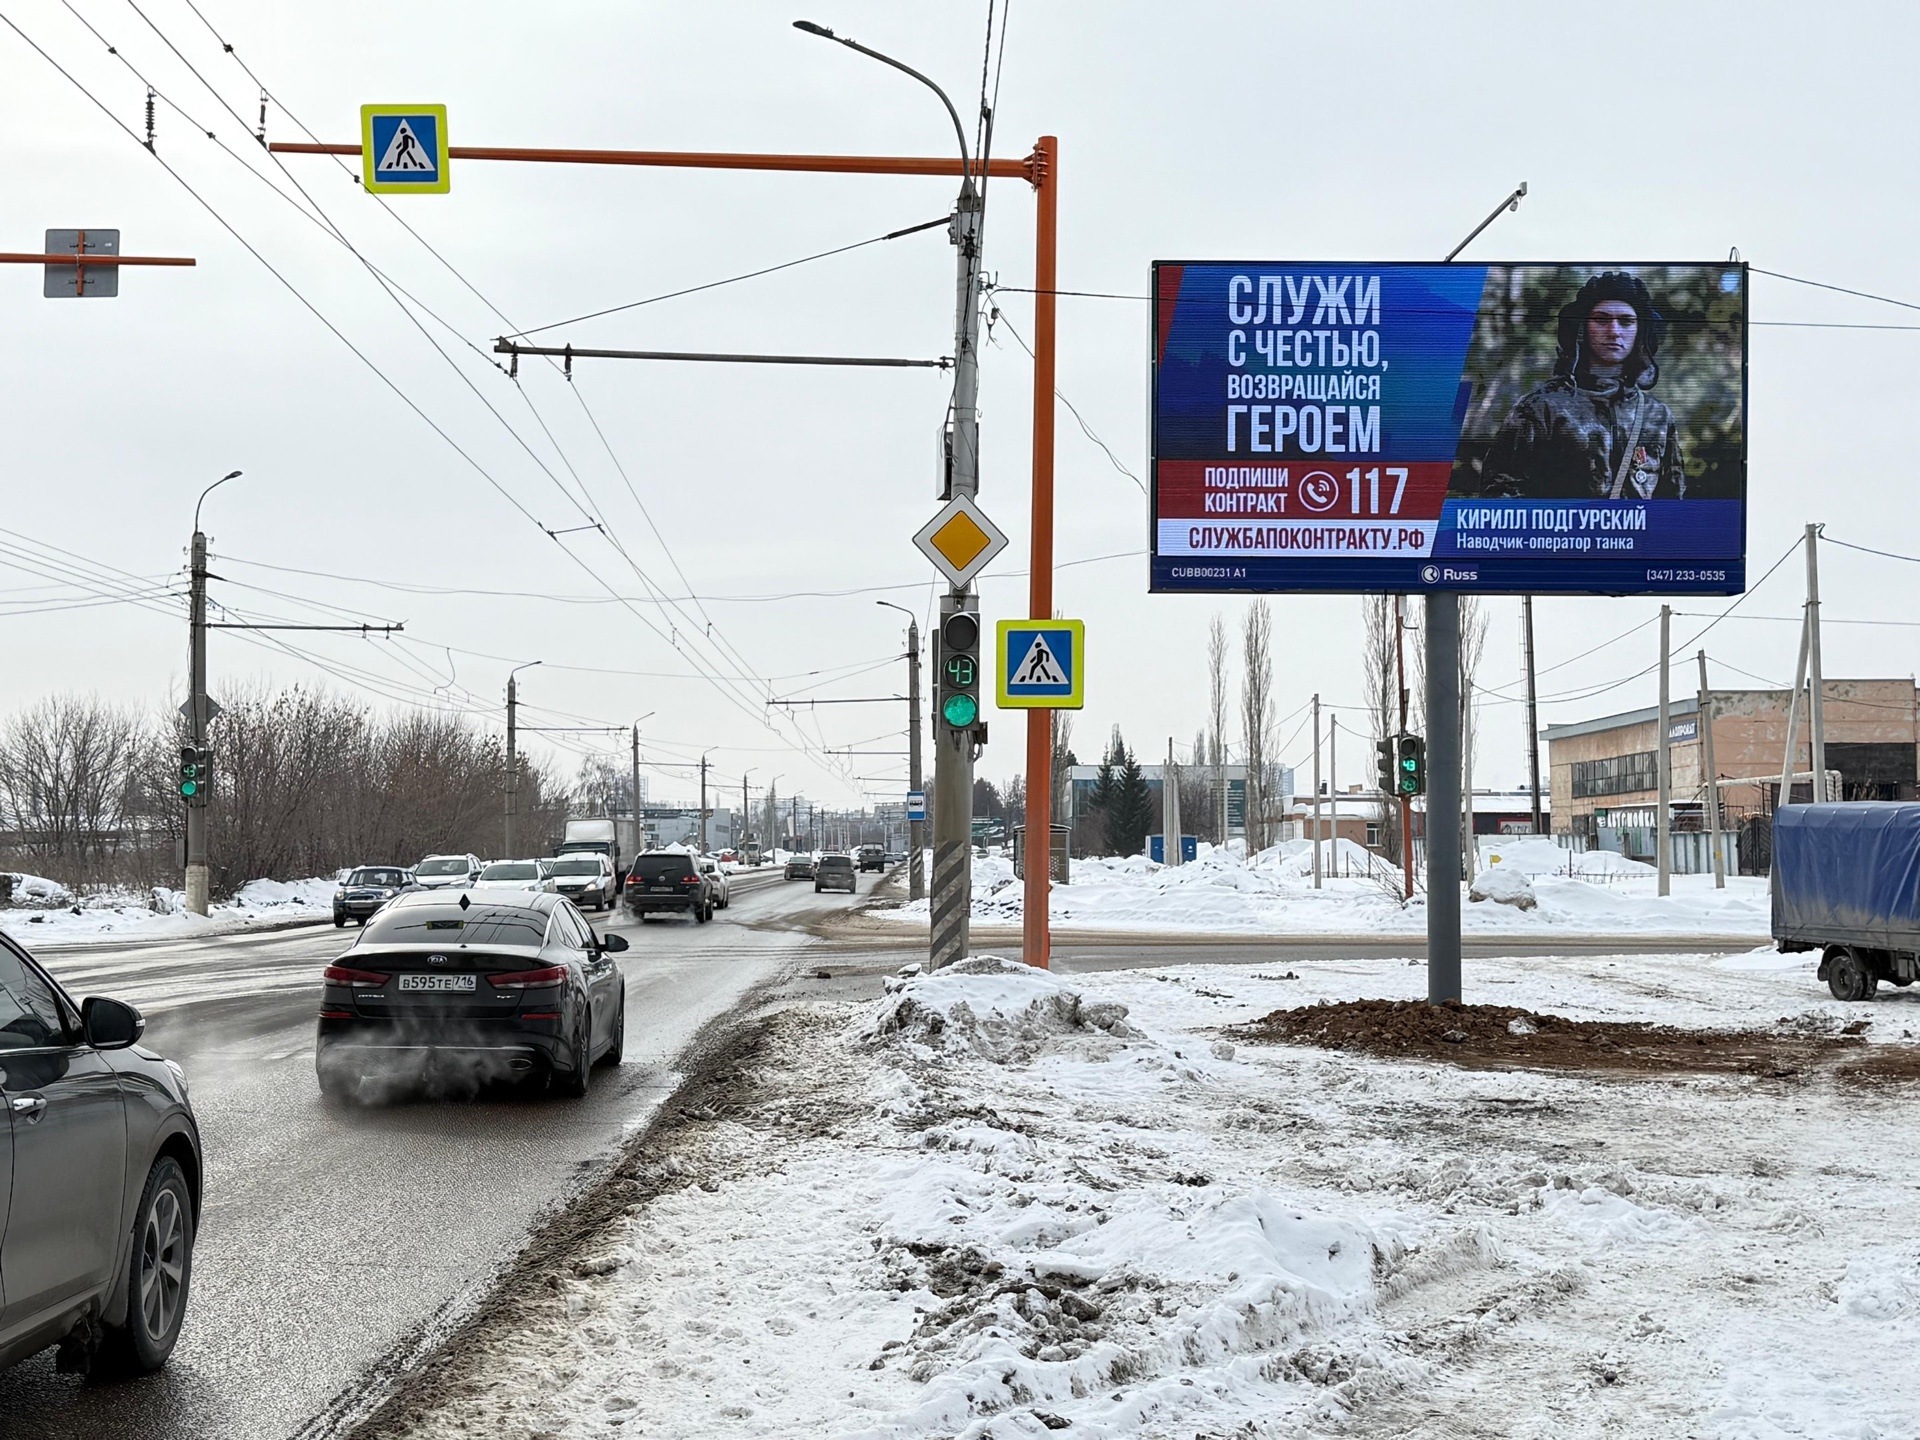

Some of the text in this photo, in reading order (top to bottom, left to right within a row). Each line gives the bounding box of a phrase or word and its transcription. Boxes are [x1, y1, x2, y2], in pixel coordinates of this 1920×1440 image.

[1228, 275, 1381, 325] СЛУЖИ
[1228, 329, 1389, 372] С ЧЕСТЬЮ,
[1227, 370, 1381, 402] ВОЗВРАЩАЙСЯ
[1227, 405, 1381, 453] ГЕРОЕМ
[1205, 467, 1288, 489] ПОДПИШИ
[1346, 467, 1409, 514] 117
[1205, 493, 1288, 513] КОНТРАКТ
[1456, 505, 1646, 532] КИРИЛЛ ПОДГУРСКИЙ
[1189, 527, 1425, 550] СЛУЖБАПОКОНТРАКТУ.РФ
[1456, 533, 1634, 552] Наводчик-оператор танка
[1171, 567, 1246, 578] CUBB00231 A1
[1443, 568, 1478, 581] Russ
[1646, 569, 1725, 582] (347) 233-0535
[948, 659, 973, 684] 43
[1402, 760, 1416, 771] 43
